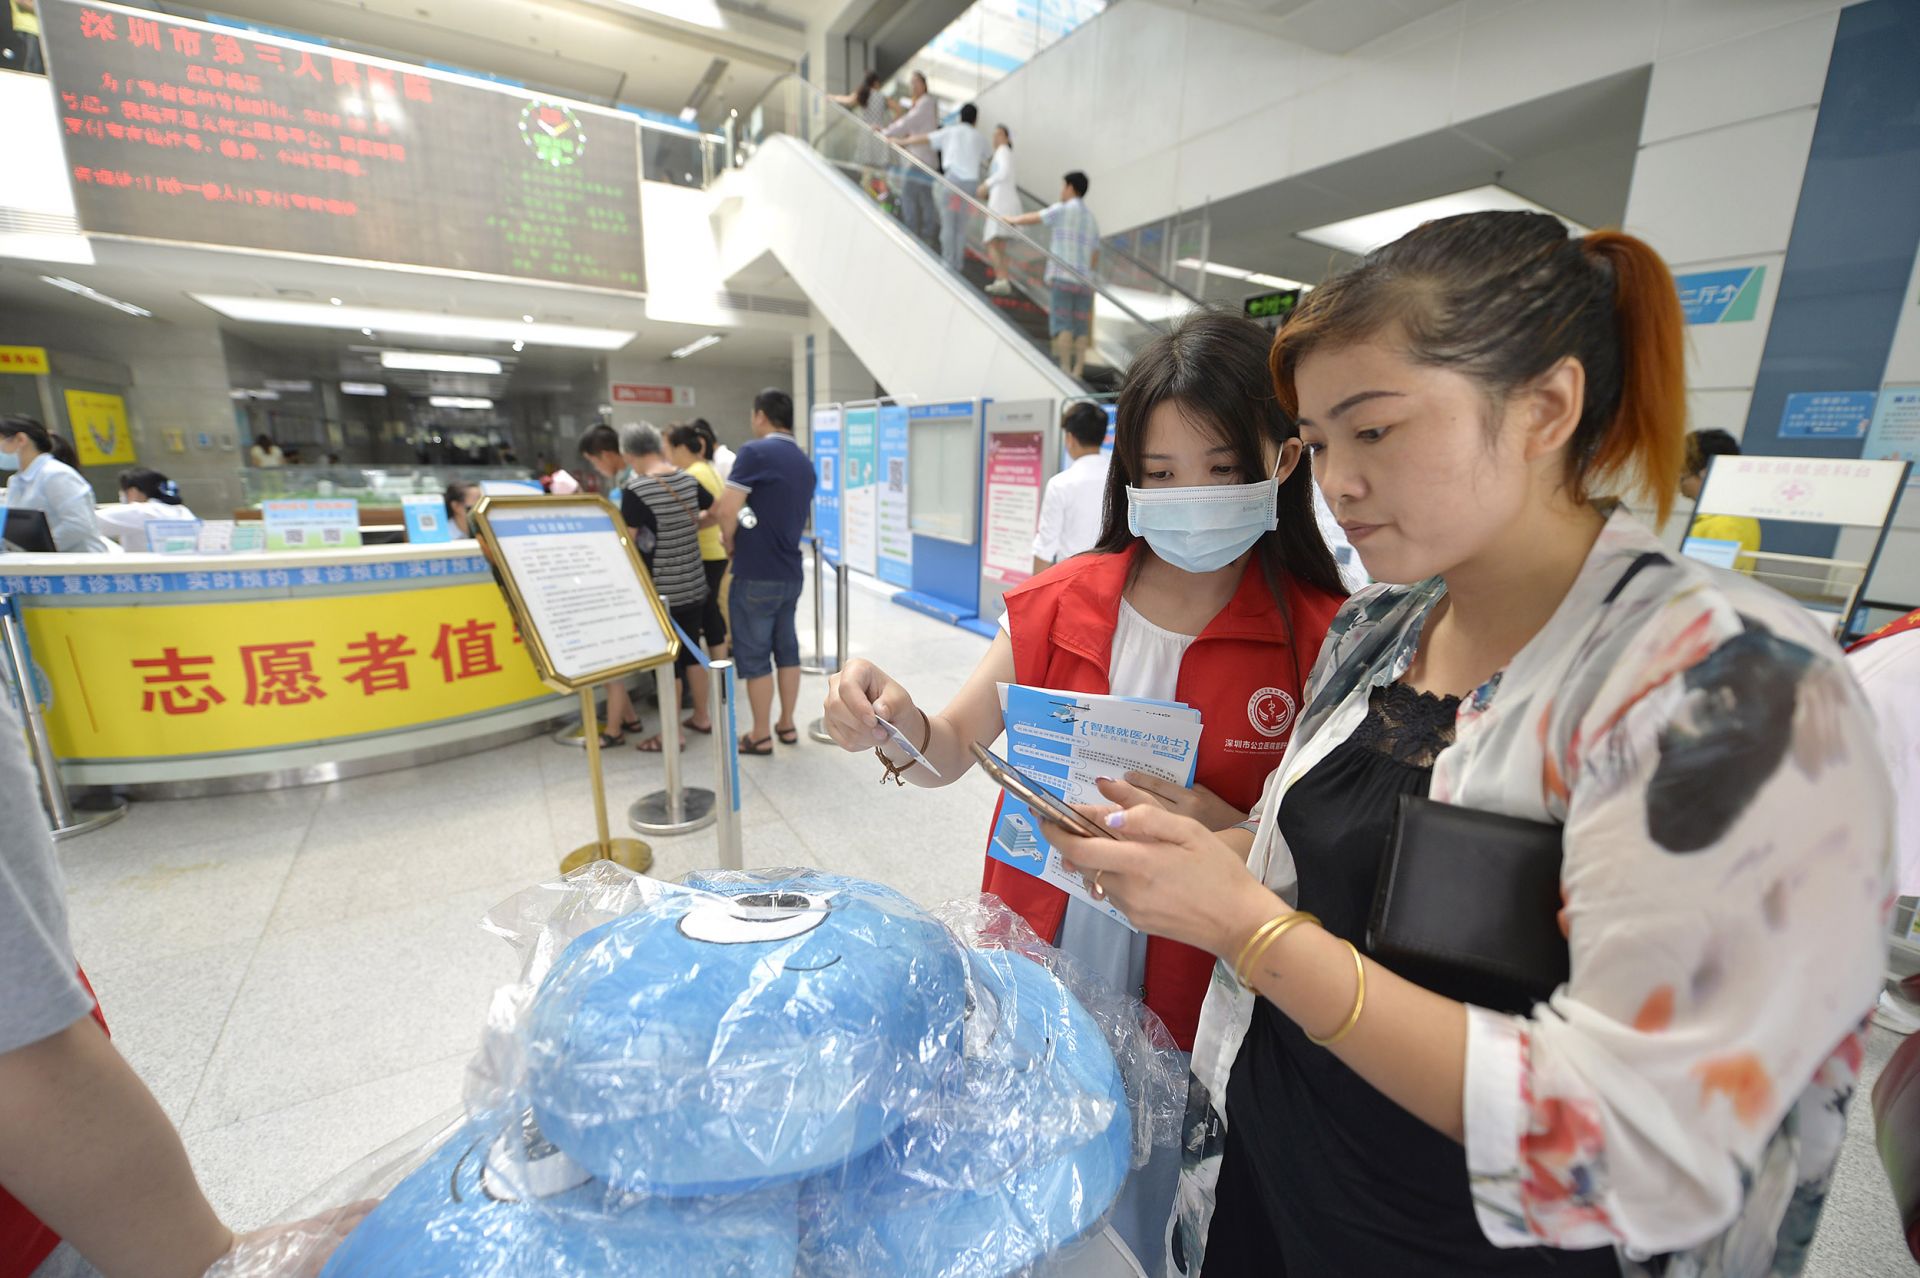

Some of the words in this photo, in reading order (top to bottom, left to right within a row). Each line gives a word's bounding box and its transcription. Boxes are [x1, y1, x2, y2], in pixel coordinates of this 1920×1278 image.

[62, 573, 164, 594] 复诊预约
[186, 569, 290, 591] 实时预约
[301, 562, 395, 585] 复诊预约
[131, 618, 524, 716] 志愿者值
